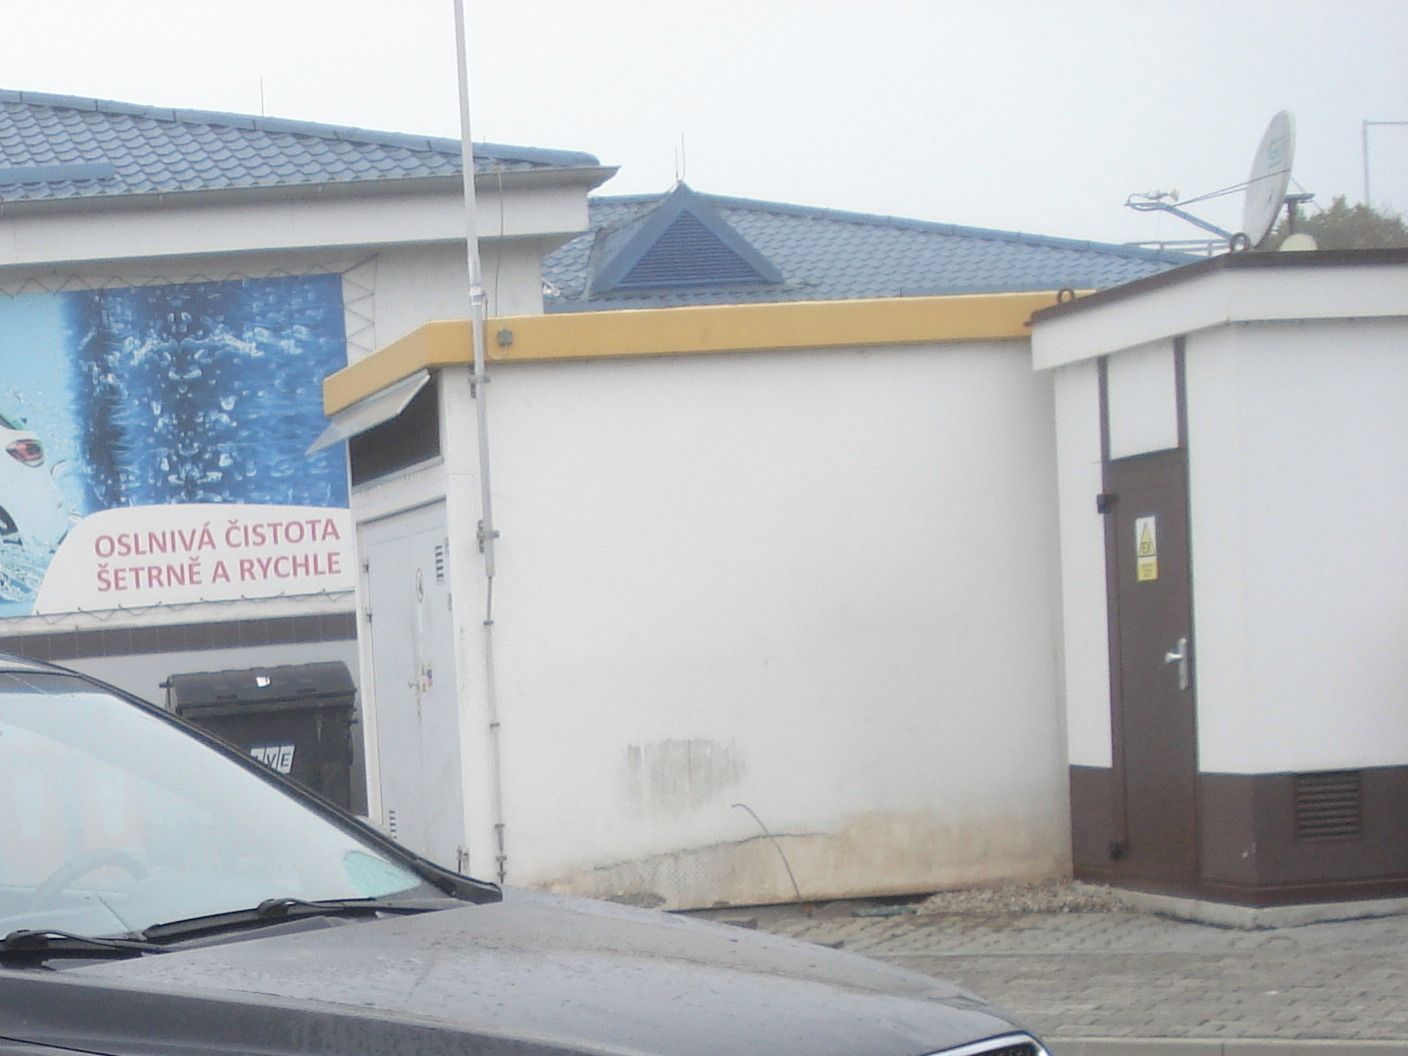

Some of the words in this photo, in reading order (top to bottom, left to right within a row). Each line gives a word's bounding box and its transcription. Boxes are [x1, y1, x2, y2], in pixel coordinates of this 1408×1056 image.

[94, 521, 217, 558] OSLNIVÁ
[224, 517, 341, 548] ČISTOTA
[96, 555, 203, 592] ŠETRNĚ
[211, 560, 231, 583] A
[239, 551, 342, 582] RYCHLE
[255, 752, 291, 769] VE
